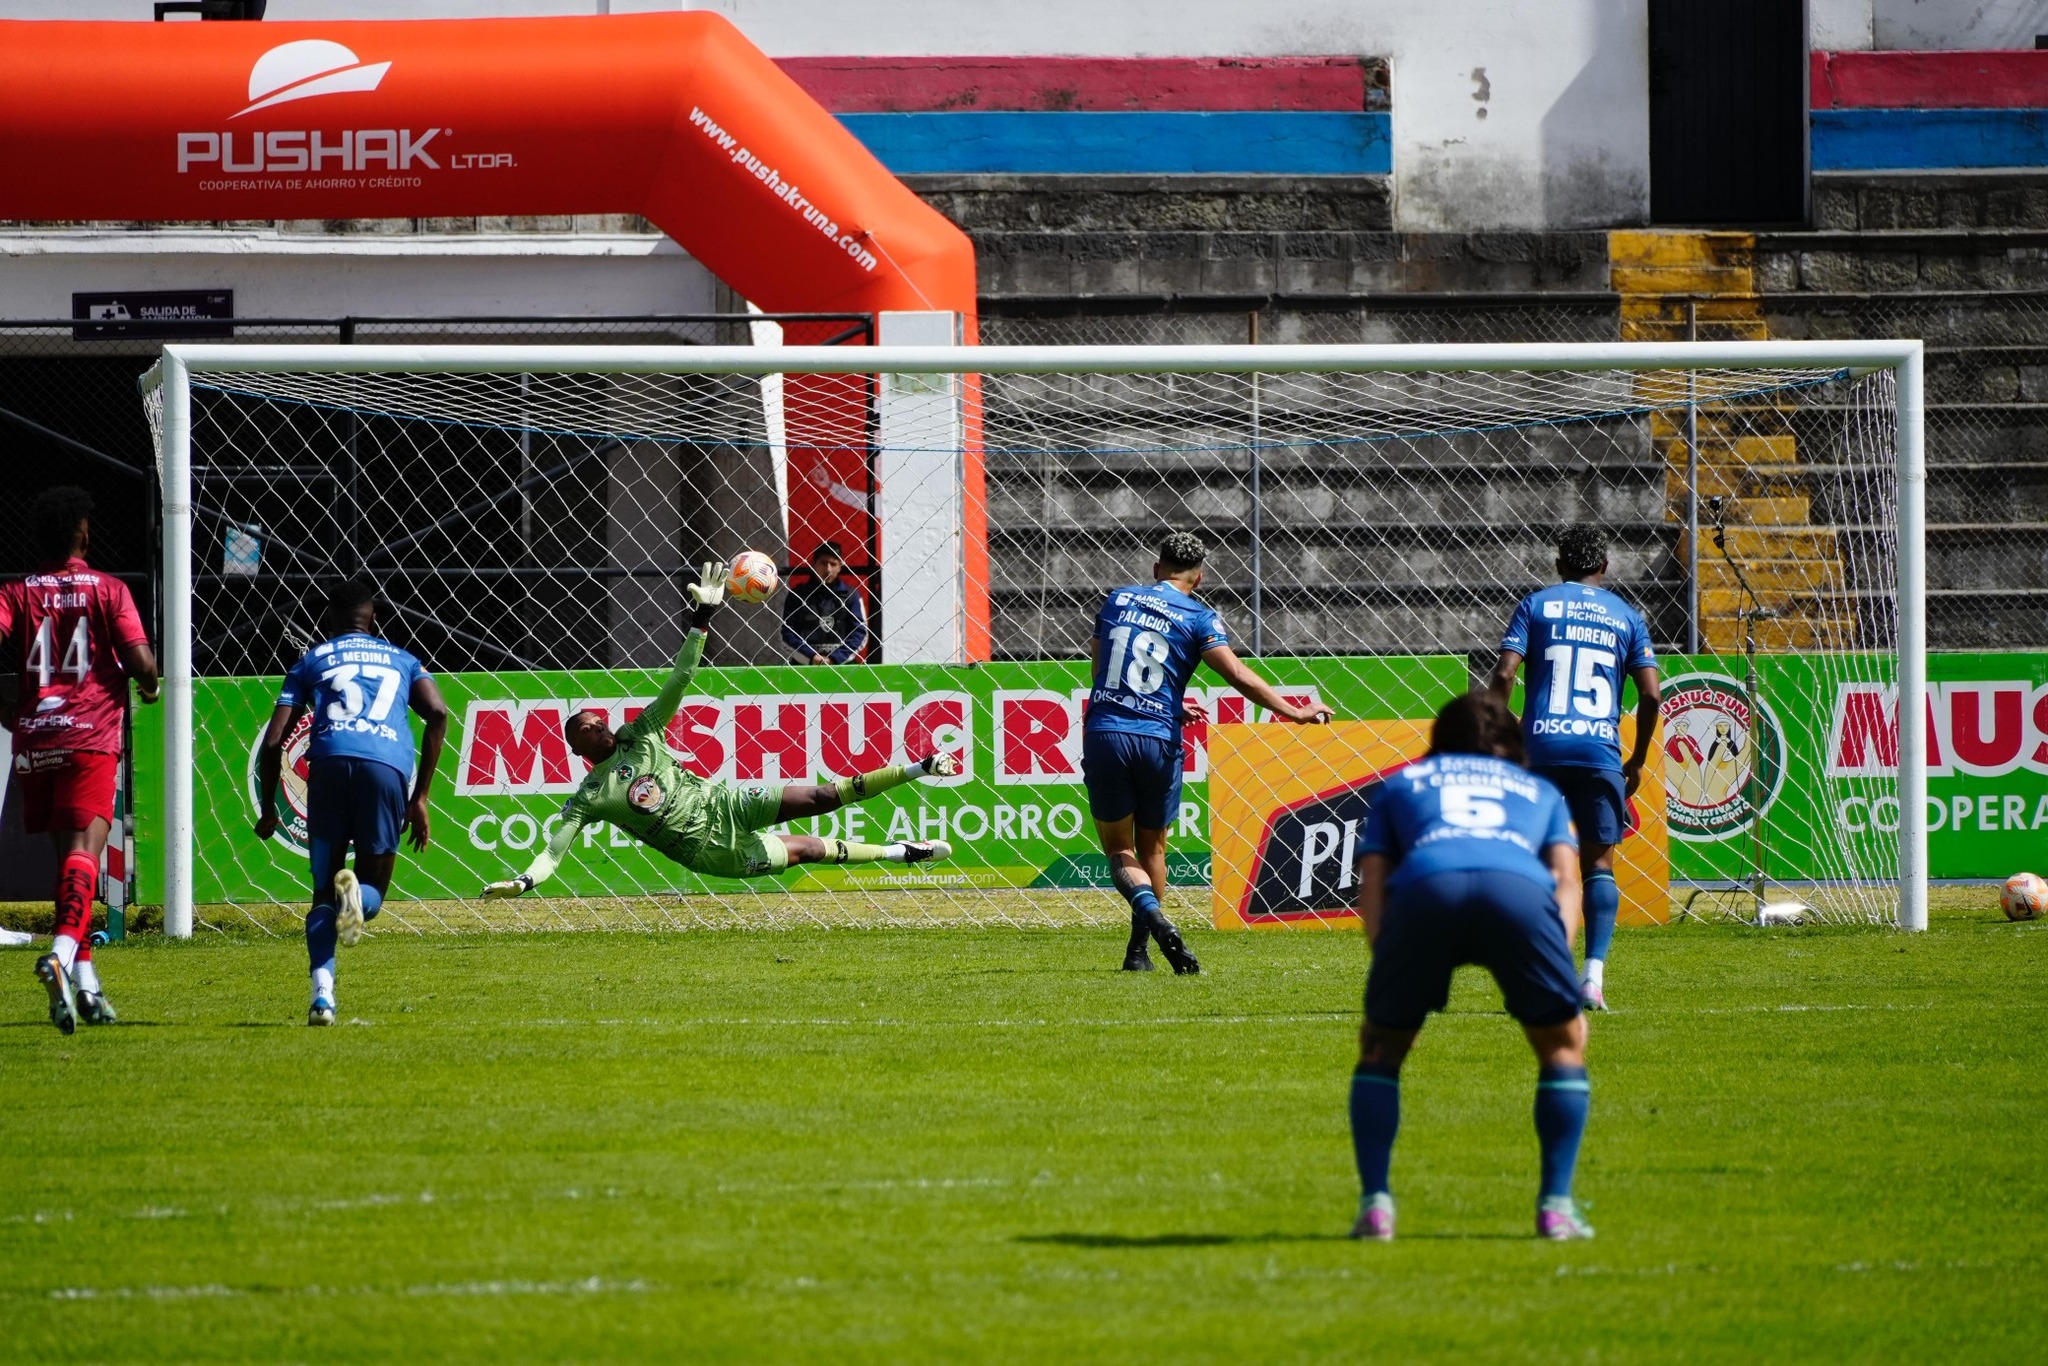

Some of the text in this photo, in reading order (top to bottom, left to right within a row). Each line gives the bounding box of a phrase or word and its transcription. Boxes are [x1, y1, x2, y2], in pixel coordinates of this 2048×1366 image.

[177, 128, 518, 173] PUSHAK LTDA.
[199, 175, 421, 191] COOPERATIVA DE AHORRO Y CRÉDITO
[688, 106, 878, 272] www.pushakruna.com
[140, 306, 197, 316] SALIDA DE
[53, 592, 87, 609] CHALA
[1134, 594, 1168, 608] BANCO
[1567, 601, 1607, 614] BANCO
[1117, 610, 1173, 634] PALACIOS
[1567, 611, 1627, 631] PICHINCHA
[1551, 624, 1617, 648] L. MORENO
[26, 615, 92, 687] 44
[327, 651, 392, 666] C. MEDINA
[1104, 625, 1170, 695] 18
[321, 663, 401, 721] 37
[1544, 644, 1616, 718] 15
[1093, 689, 1165, 714] DISCOVER
[1660, 690, 1712, 716] USHUC
[1532, 719, 1614, 741] DISCOVER
[1440, 784, 1508, 830] 5
[1666, 808, 1700, 826] HORRO
[1701, 817, 1709, 826] Y
[885, 803, 1083, 842] AHORRO
[843, 872, 996, 886] www.mushucruna.com
